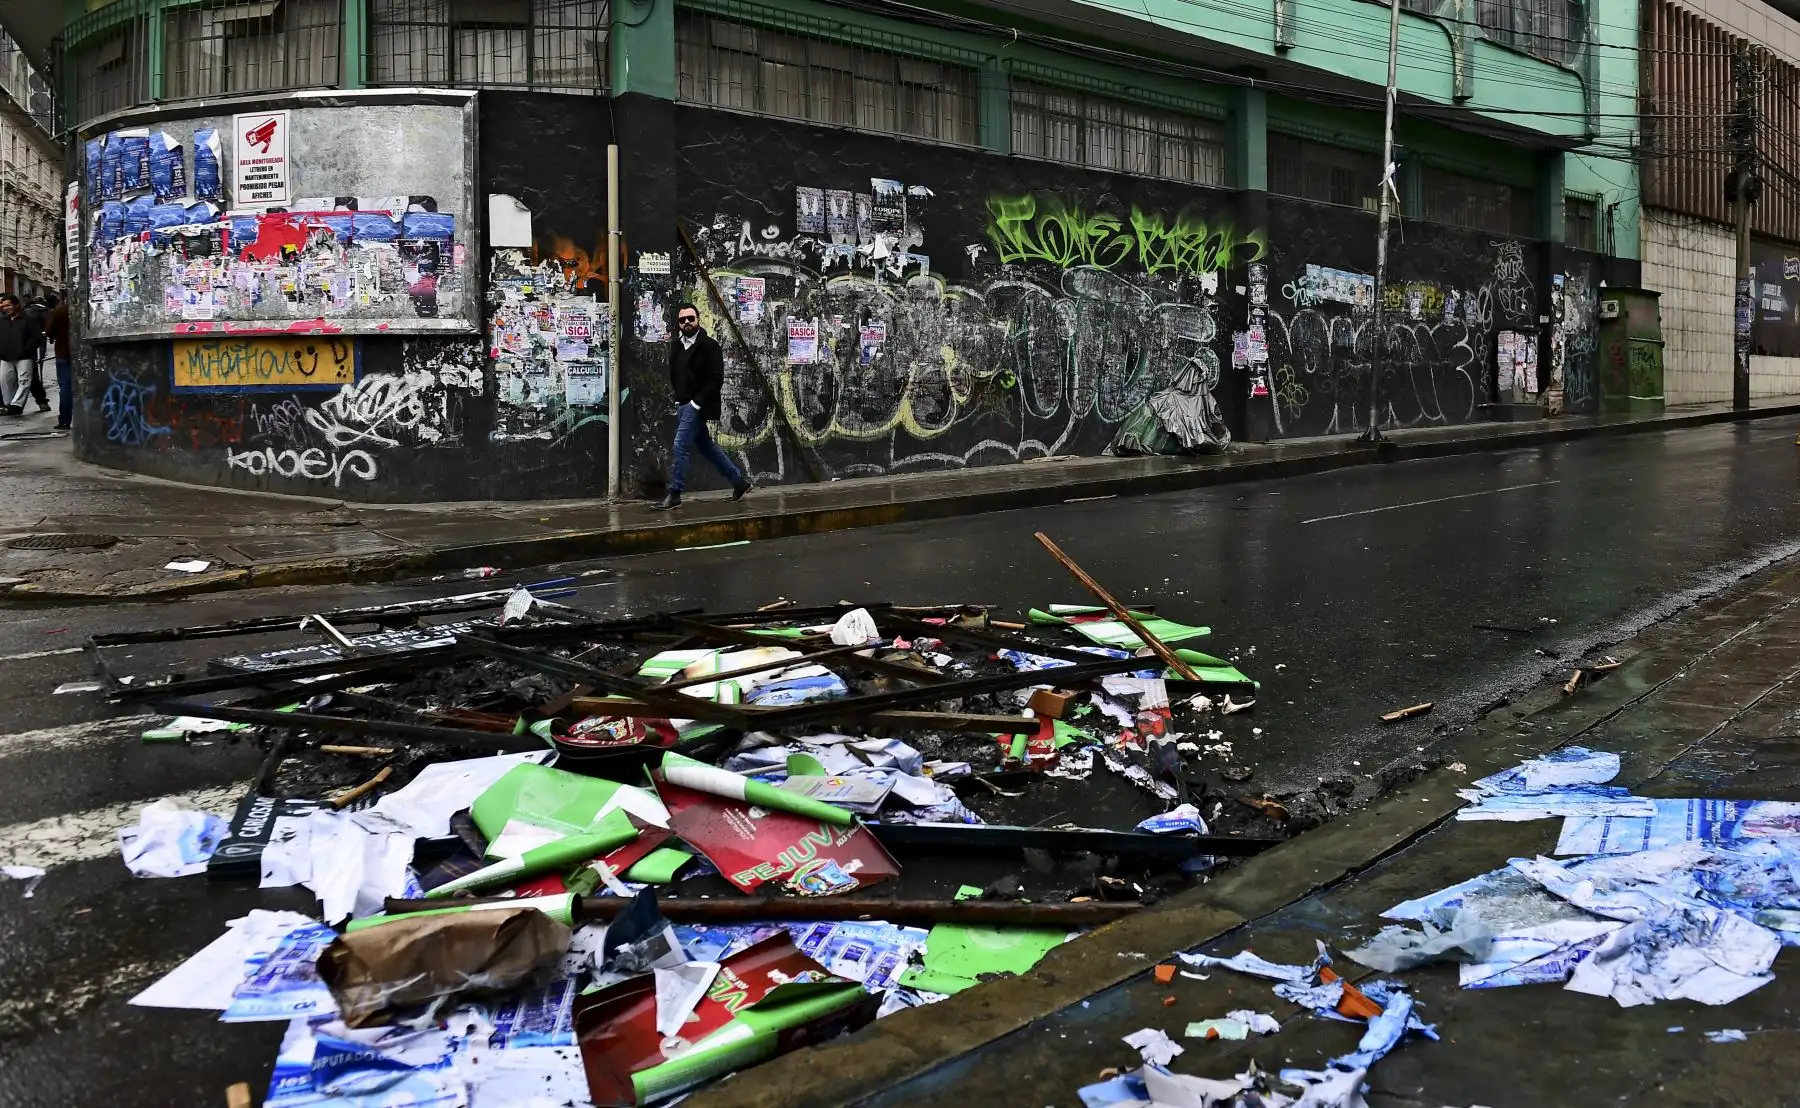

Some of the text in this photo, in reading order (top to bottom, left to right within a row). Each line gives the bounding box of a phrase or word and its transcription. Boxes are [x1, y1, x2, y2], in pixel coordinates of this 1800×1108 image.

[245, 173, 279, 181] MANTENIMIENTO
[240, 181, 285, 191] PROHIBIDO PEGAR
[790, 327, 816, 337] BASICA
